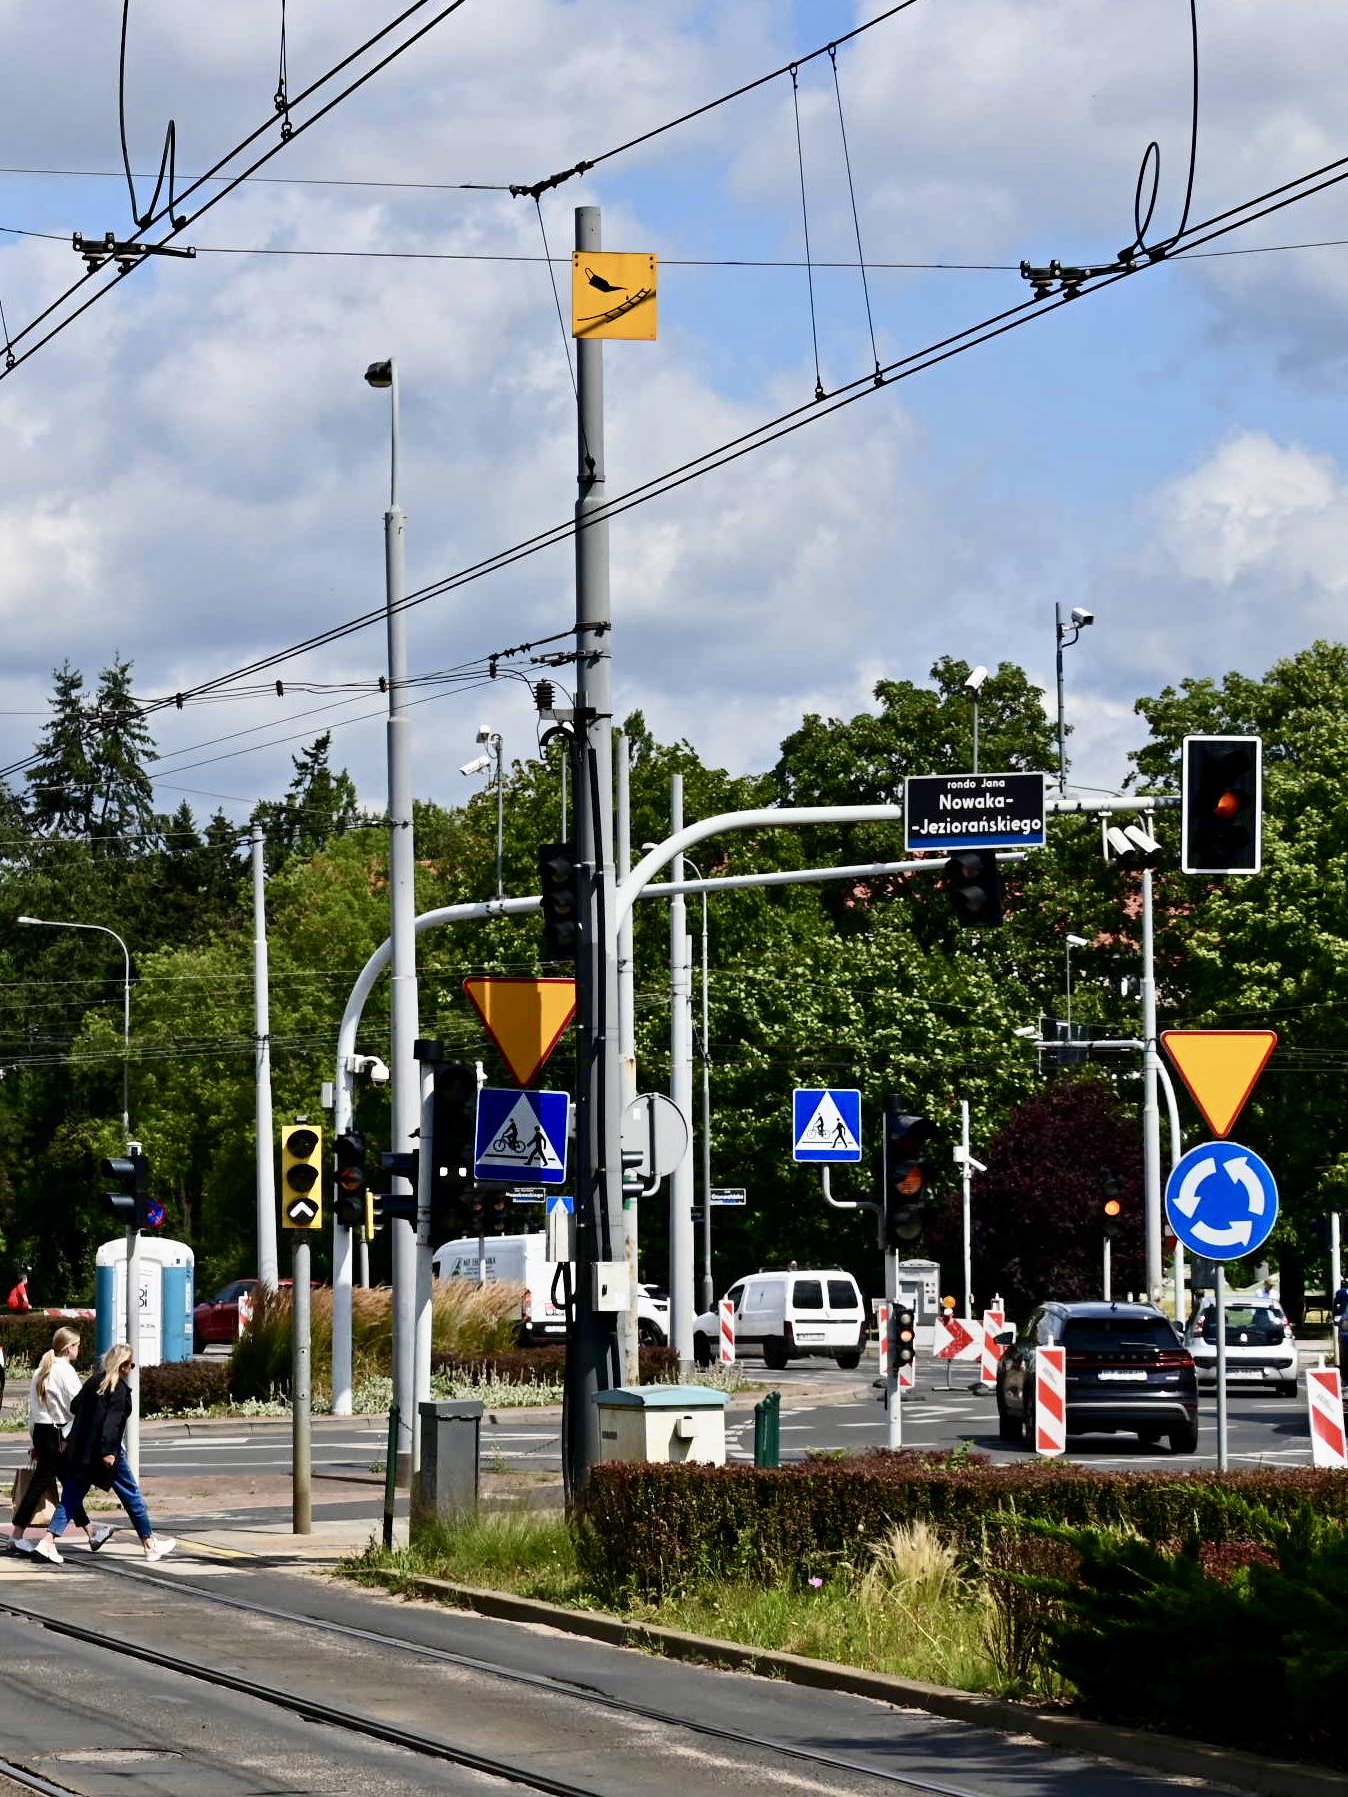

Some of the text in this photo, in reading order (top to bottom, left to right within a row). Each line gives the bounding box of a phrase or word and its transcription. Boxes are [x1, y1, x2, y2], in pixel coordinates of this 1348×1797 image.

[947, 777, 1006, 789] rondo Jana
[939, 792, 1014, 810] Nowaka-
[911, 815, 1042, 835] -Jeziorańskiego
